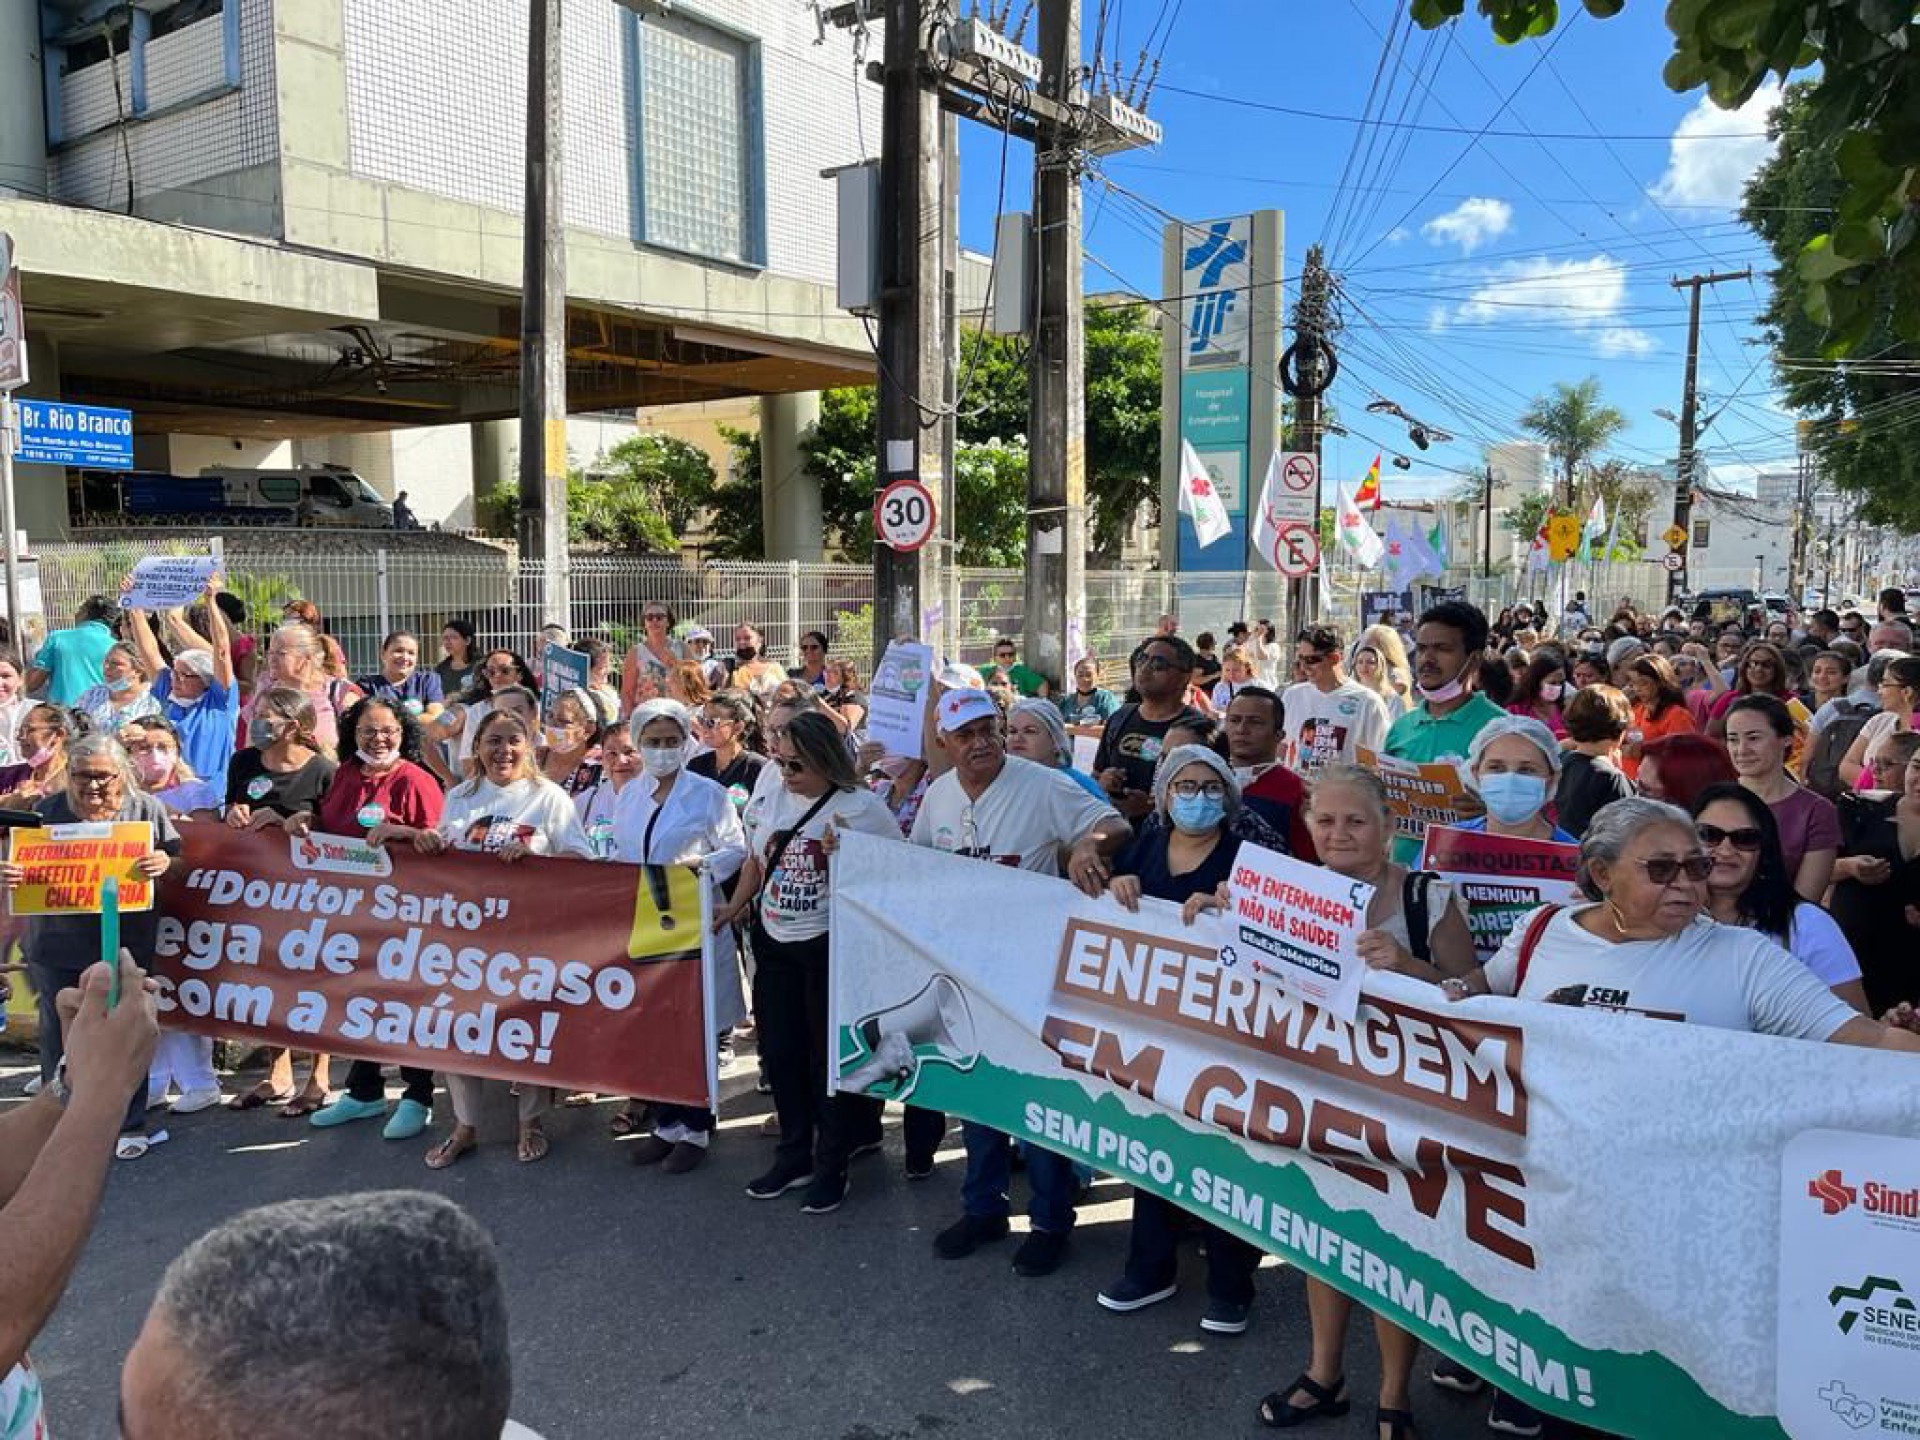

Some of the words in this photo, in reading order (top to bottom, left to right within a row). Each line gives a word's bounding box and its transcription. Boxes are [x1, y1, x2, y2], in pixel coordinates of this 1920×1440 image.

[24, 407, 45, 428] Br.
[49, 408, 73, 431] Rio
[78, 411, 131, 435] Branco
[886, 497, 925, 527] 30
[23, 864, 86, 885] REFEITO
[45, 885, 94, 908] CULPA
[1234, 866, 1260, 893] SEM
[1262, 876, 1355, 928] ENFERMAGEM
[1466, 886, 1535, 902] NENHUM
[1238, 896, 1264, 923] NÃO
[1268, 907, 1285, 932] HÁ
[1289, 918, 1340, 953] SAÚDE!
[278, 918, 360, 974] de
[376, 927, 636, 1010] descaso
[1588, 987, 1630, 1005] SEM
[151, 975, 274, 1026] com
[286, 990, 328, 1033] a
[340, 992, 560, 1064] saúde!
[1064, 929, 1517, 1117] ENFERMAGEM
[1041, 1014, 1165, 1100] EM
[1864, 1181, 1918, 1218] Sind
[1024, 1102, 1092, 1154] SEM
[1098, 1129, 1186, 1197] PISO,
[1191, 1167, 1264, 1228] SEM
[1269, 1201, 1597, 1409] ENFERMAGEM!
[1864, 1306, 1920, 1332] SENE
